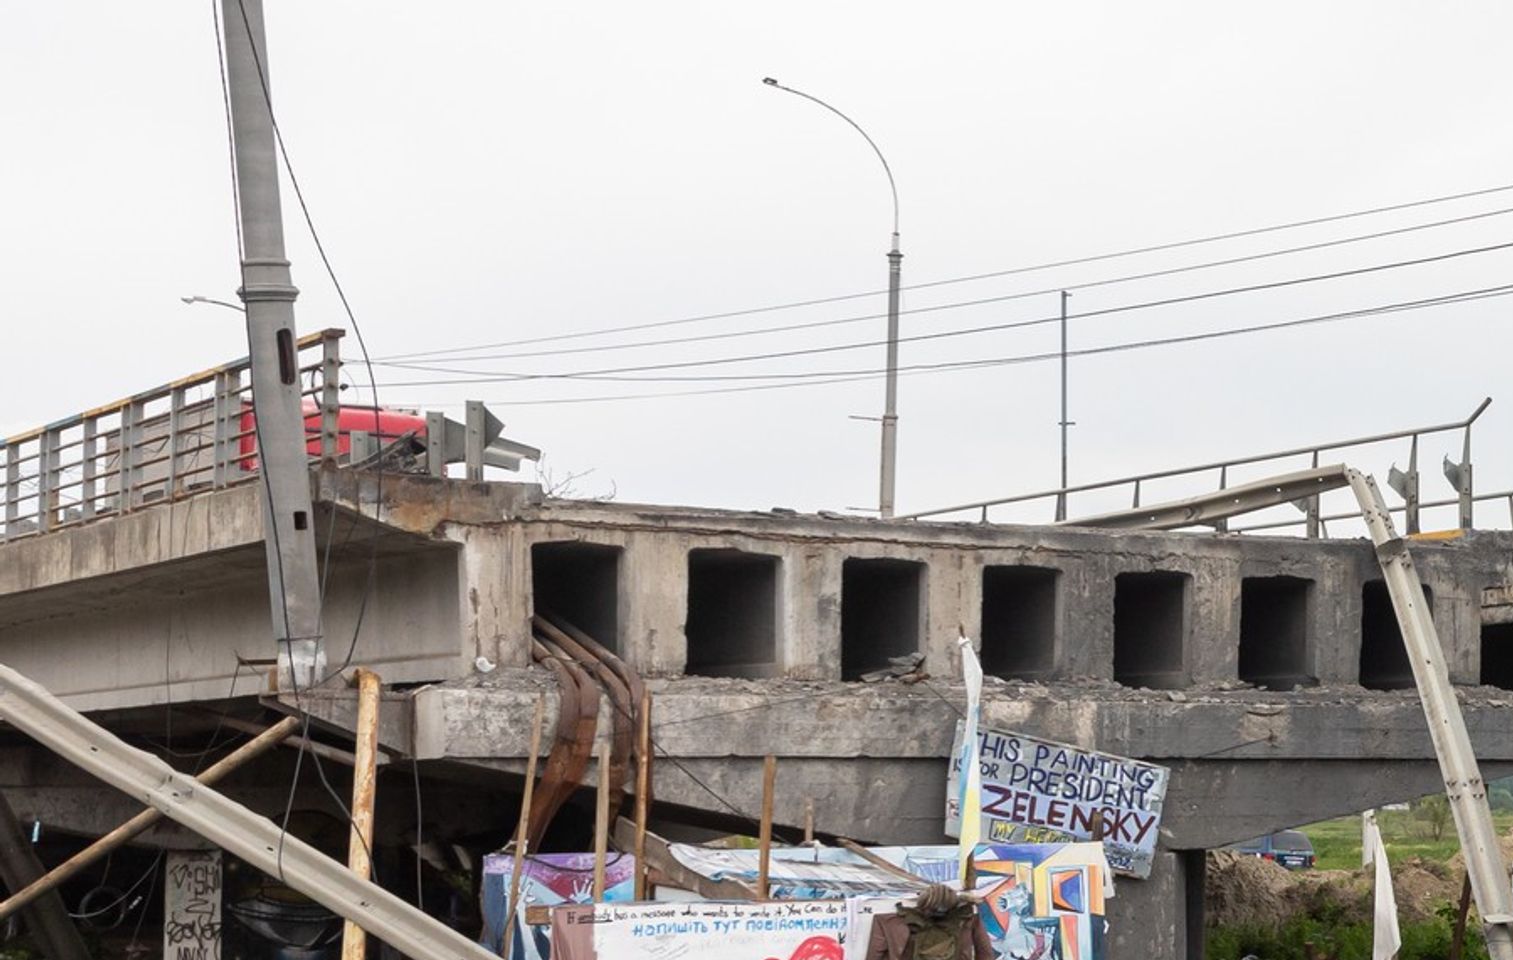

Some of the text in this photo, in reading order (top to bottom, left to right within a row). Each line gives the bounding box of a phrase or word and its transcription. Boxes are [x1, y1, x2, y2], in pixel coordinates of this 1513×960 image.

[980, 761, 999, 780] OR
[1009, 762, 1149, 810] PRESIDENT
[1033, 744, 1155, 790] PAINTING
[981, 783, 1156, 844] ZELENSKY
[681, 904, 698, 916] who
